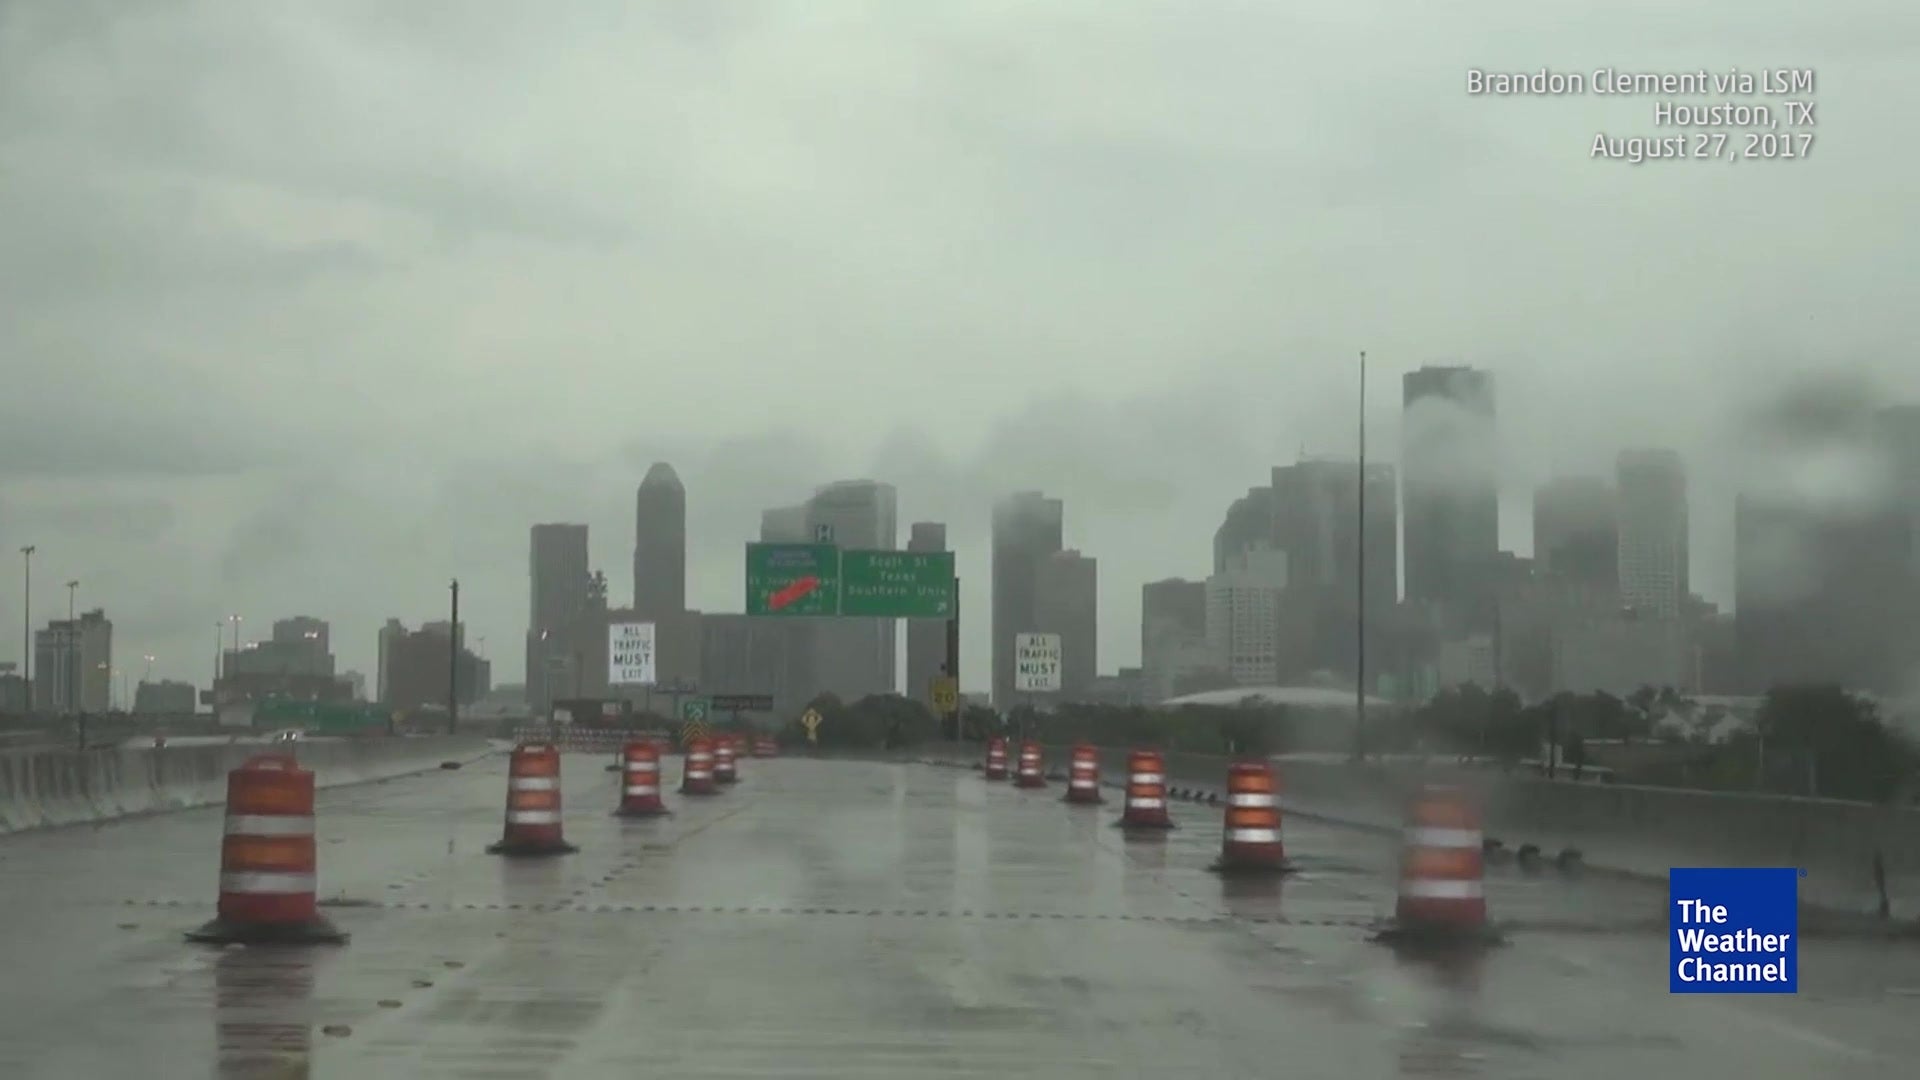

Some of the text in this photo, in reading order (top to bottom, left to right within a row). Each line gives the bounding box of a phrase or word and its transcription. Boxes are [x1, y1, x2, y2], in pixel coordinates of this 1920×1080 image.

[880, 570, 916, 582] Texas
[848, 585, 908, 596] Southern
[623, 626, 640, 637] ALL
[613, 639, 651, 651] TRAFFIC
[1030, 636, 1047, 647] ALL
[613, 652, 650, 666] MUST
[1020, 647, 1059, 661] TRAFFIC
[622, 668, 643, 679] EXIT
[1020, 661, 1056, 675] MUST
[1027, 677, 1049, 688] EXIT
